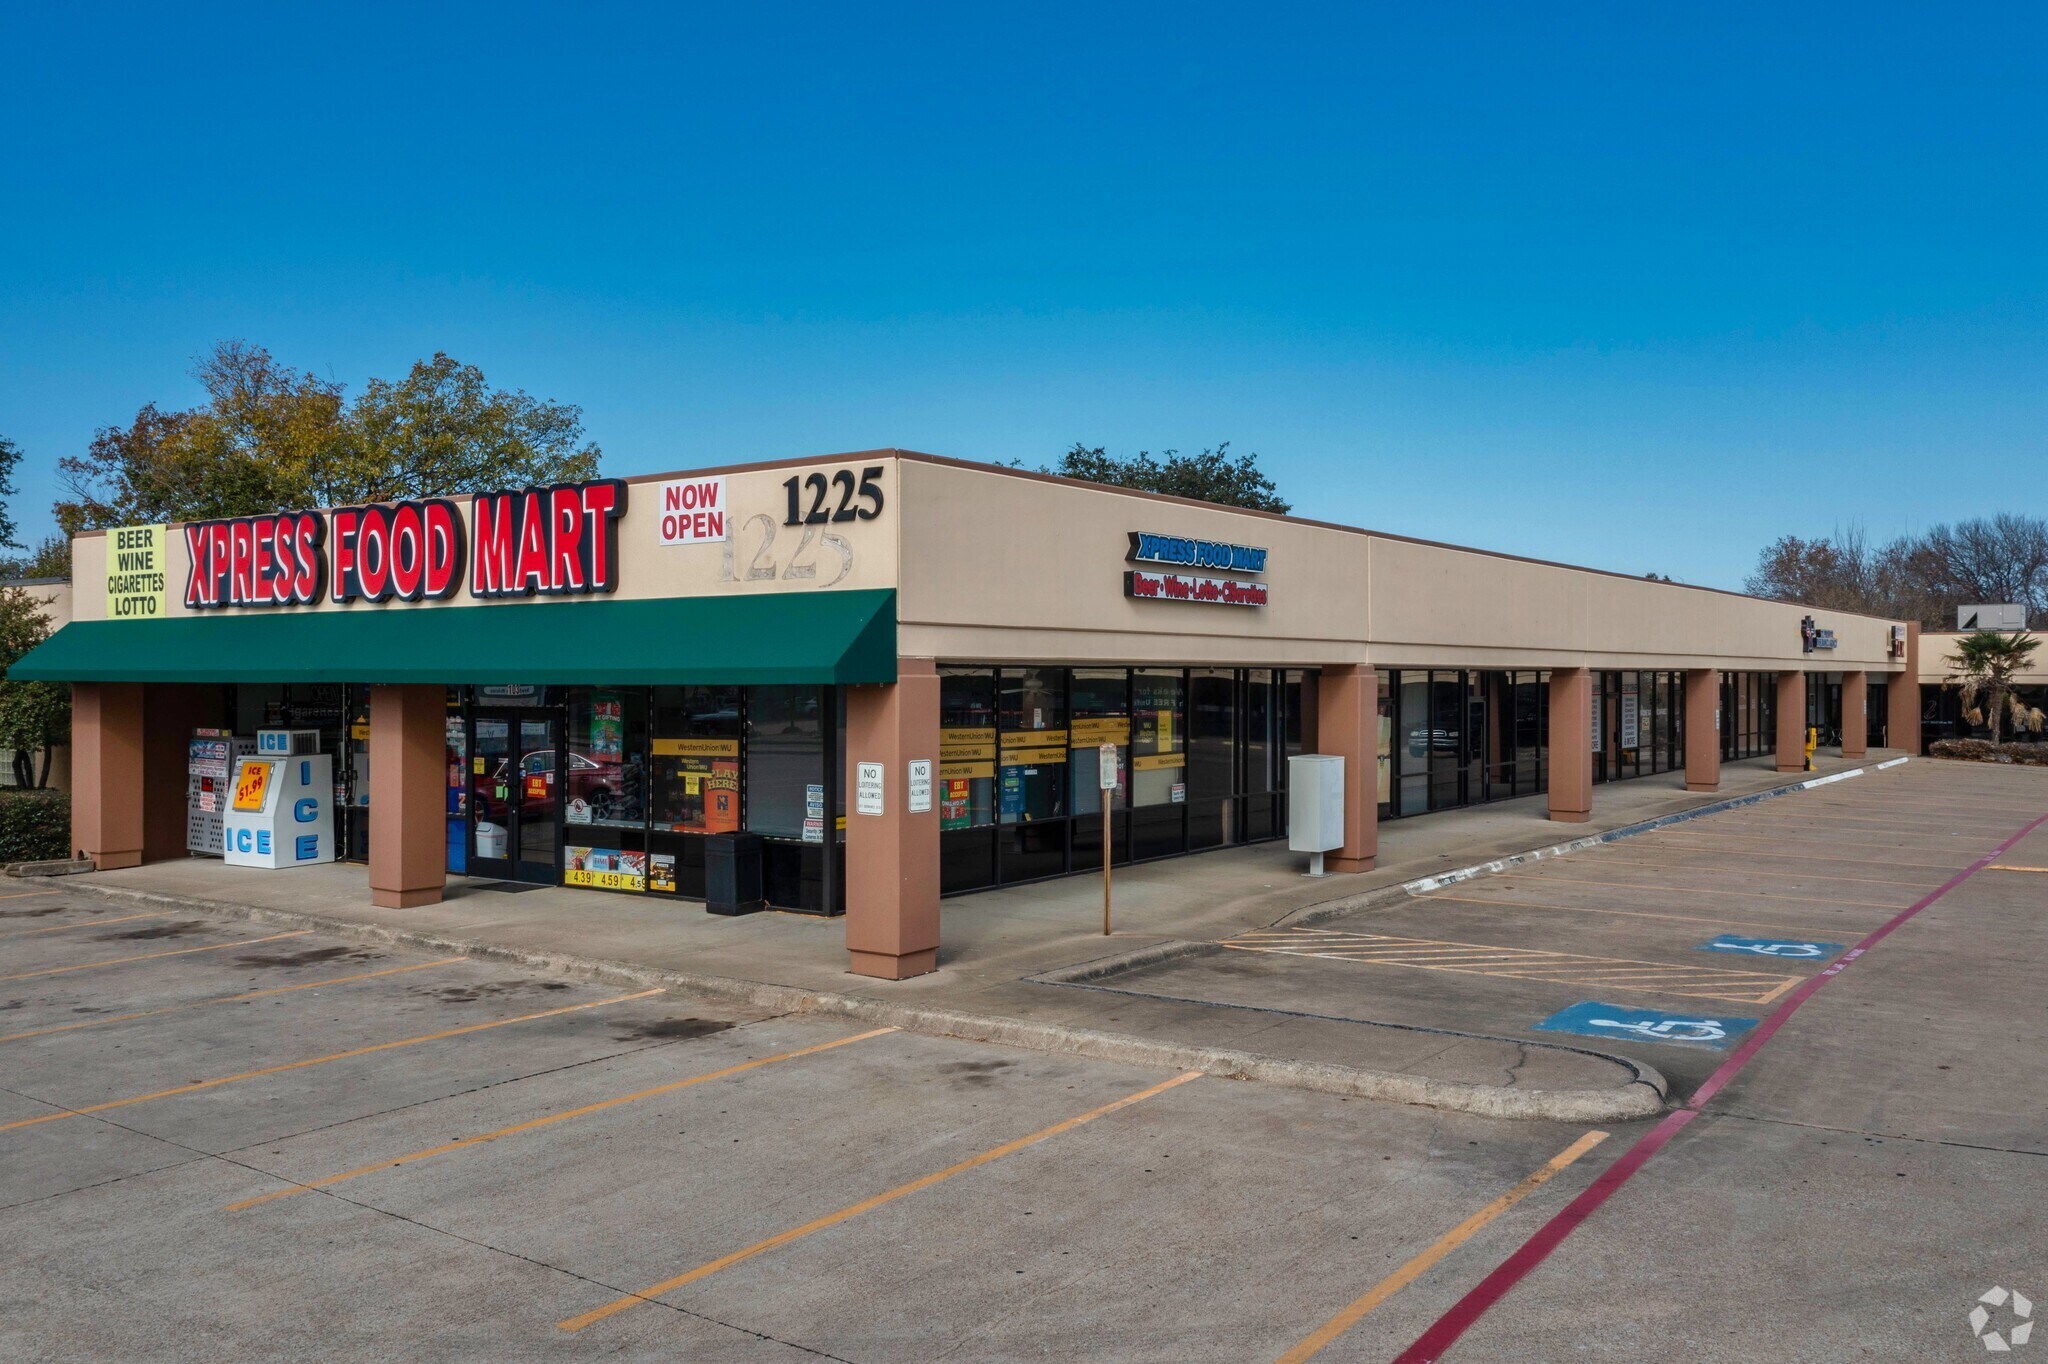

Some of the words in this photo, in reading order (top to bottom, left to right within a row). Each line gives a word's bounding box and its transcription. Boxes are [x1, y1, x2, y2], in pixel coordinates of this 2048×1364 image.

[665, 482, 719, 511] NOW
[783, 466, 885, 527] 1225
[661, 511, 724, 541] OPEN
[116, 529, 153, 550] BEER
[186, 511, 319, 605] XPRESS
[332, 502, 455, 600] FOOD
[474, 483, 616, 594] MART
[117, 551, 154, 571] WINE
[1139, 534, 1196, 564] XPRESS
[1196, 541, 1231, 567] FOOD
[1231, 545, 1267, 571] MART
[108, 573, 164, 593] CIGARETTES
[1134, 572, 1159, 597] Beer
[1163, 575, 1189, 599] Wine
[1192, 578, 1218, 601] Lotto
[1221, 580, 1267, 605] Cigarettes
[114, 595, 157, 616] LOTTO
[259, 733, 287, 751] ICE
[248, 766, 262, 775] ICE
[863, 769, 877, 779] NO
[915, 766, 926, 776] NO
[238, 776, 263, 802] $1.99
[531, 779, 542, 788] EBT
[859, 781, 882, 789] LOITERING
[910, 778, 930, 787] LOITERING
[953, 781, 965, 790] EBT
[859, 792, 881, 800] ALLOWED
[911, 789, 930, 797] ALLOWED
[293, 760, 319, 861] ICE
[225, 827, 272, 855] ICE
[573, 871, 592, 883] 4.39
[601, 874, 619, 887] 4.59
